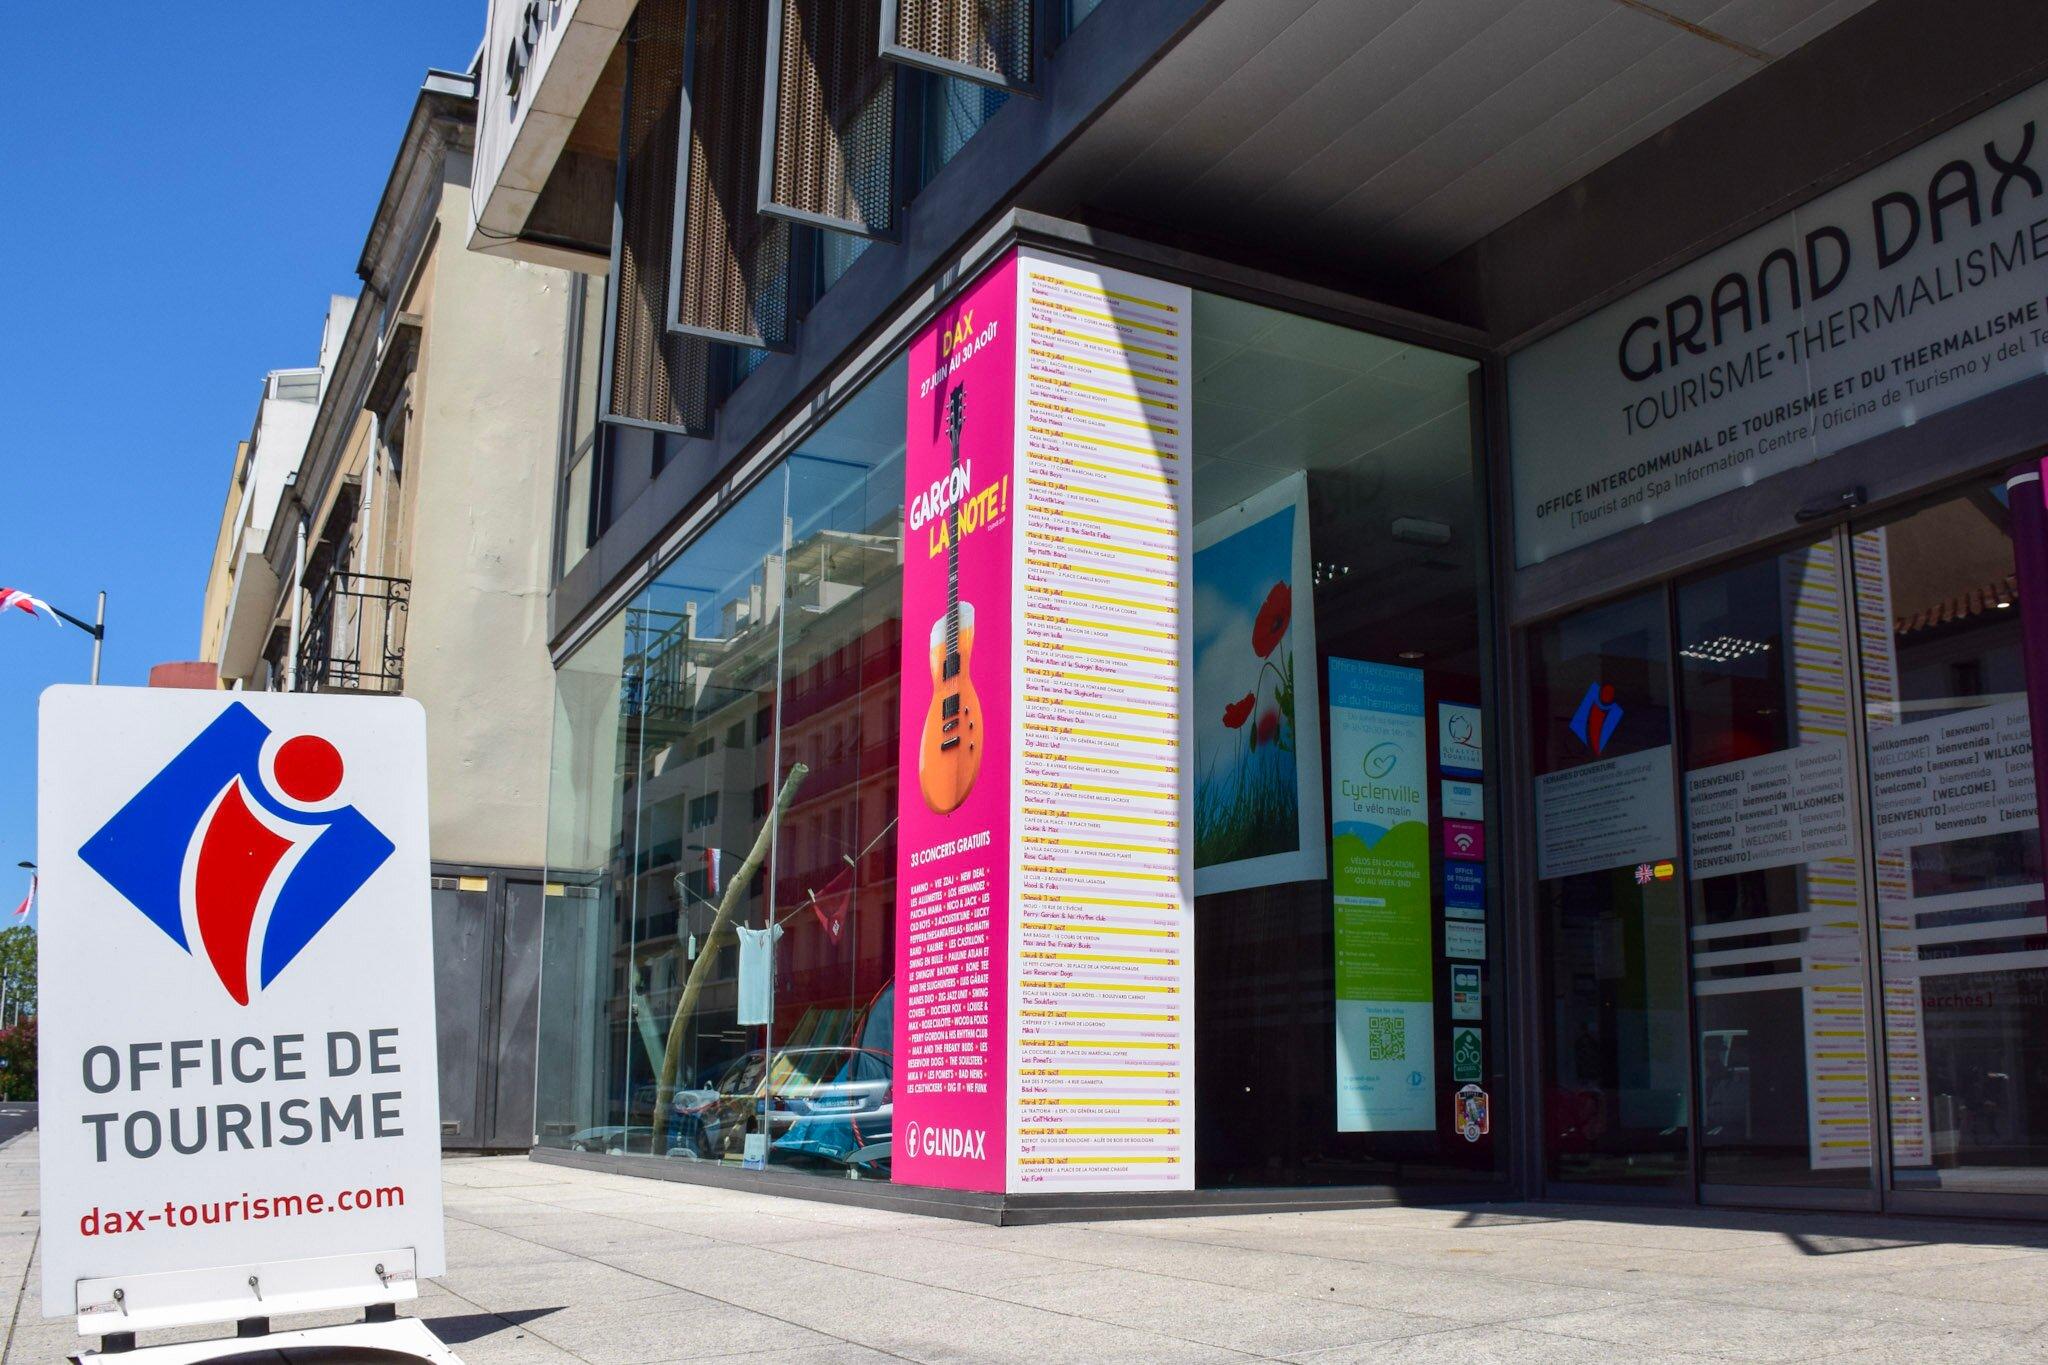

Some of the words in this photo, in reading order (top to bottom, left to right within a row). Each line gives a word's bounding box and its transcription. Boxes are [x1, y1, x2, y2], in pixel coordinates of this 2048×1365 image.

[1618, 226, 1851, 382] GRAND
[1873, 120, 2044, 270] DAX
[943, 309, 974, 357] DAX
[921, 378, 930, 398] 27
[930, 363, 948, 390] JUIN
[949, 352, 961, 374] AU
[962, 343, 972, 362] 30
[974, 320, 998, 353] AOÛT
[1537, 488, 1582, 518] OFFICE
[1586, 437, 1713, 499] INTERCOMMUNAL
[1718, 425, 1738, 446] DE
[1742, 388, 1828, 436] TOURISME
[1834, 377, 1855, 400] ET
[1861, 364, 1885, 389] DU
[1891, 301, 2038, 375] THERMALISME
[1620, 486, 1643, 508] and
[1647, 480, 1671, 499] Spa
[1675, 448, 1754, 487] Information
[1758, 427, 1807, 455] Centre
[1822, 400, 1876, 430] Oficina
[1882, 389, 1901, 407] de
[1906, 360, 1976, 396] Turismo
[1982, 354, 1991, 373] y
[1997, 336, 2026, 362] del
[910, 459, 971, 531] GARÇON
[930, 519, 950, 559] LA
[1871, 733, 1929, 752] willkommen
[1940, 718, 1994, 740] [BENVENUTO]
[1935, 736, 1989, 755] bienvenida
[1025, 767, 1039, 775] Swing
[1041, 769, 1059, 777] Covers
[1689, 770, 1744, 791] [BIENVENUE]
[1751, 763, 1787, 777] welcome
[1873, 764, 1922, 781] benvenuto
[1926, 752, 1979, 772] [BIENVENUE]
[1874, 776, 1927, 796] [welcome]
[1939, 766, 1991, 784] bienvenida
[1342, 780, 1420, 803] Cyclenville
[1690, 787, 1737, 802] willkommen
[1742, 790, 1786, 806] bienvenida
[1932, 779, 1996, 801] [WELCOME]
[1354, 803, 1362, 812] Le
[1366, 804, 1383, 814] vélo
[1387, 806, 1411, 816] malin
[1691, 815, 1732, 829] benvenuto
[1781, 793, 1844, 812] WILLKOMMEN
[1934, 815, 1987, 830] benvenuto
[1692, 826, 1734, 843] [welcome]
[1745, 819, 1787, 833] bienvenida
[1692, 842, 1731, 855] bienvenue
[1740, 831, 1792, 848] [WELCOME]
[1801, 822, 1847, 837] bienvenida
[910, 852, 920, 868] 33
[919, 842, 956, 865] CONCERTS
[956, 830, 991, 853] GRATUITS
[1693, 851, 1751, 870] [BENVENUTO]
[1344, 867, 1375, 875] GRATUITE
[1058, 941, 1076, 949] Freaky
[82, 1033, 307, 1095] OFFICE
[327, 1027, 401, 1077] DE
[82, 1092, 405, 1163] TOURISME
[923, 1127, 986, 1161] GLNDAX
[80, 1184, 405, 1237] dax-tourisme.com
